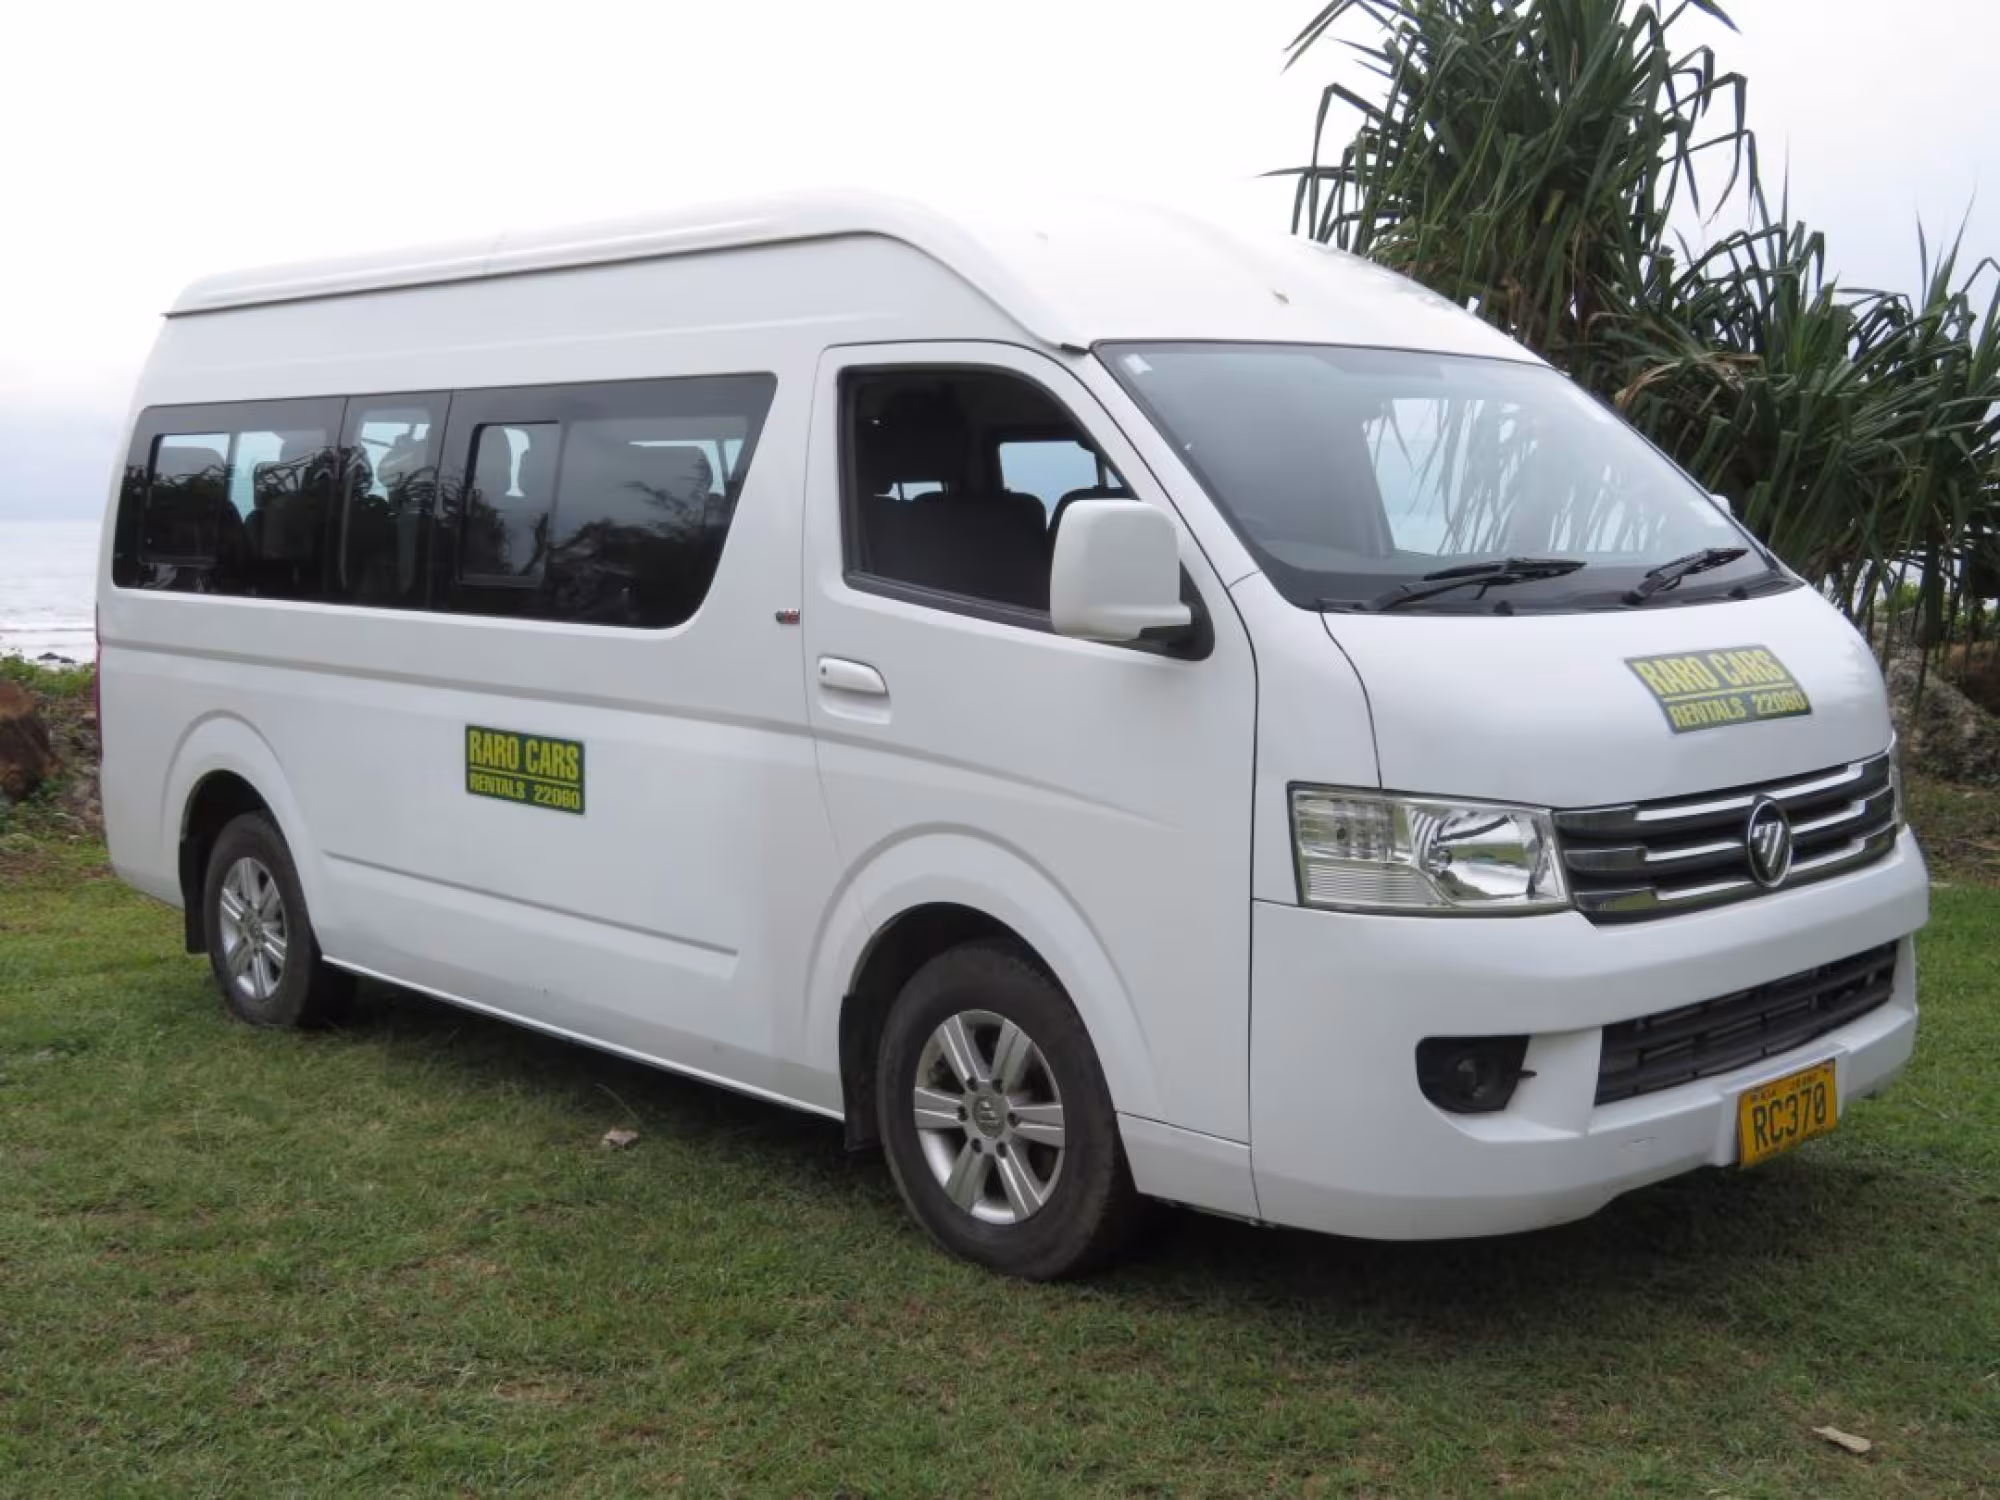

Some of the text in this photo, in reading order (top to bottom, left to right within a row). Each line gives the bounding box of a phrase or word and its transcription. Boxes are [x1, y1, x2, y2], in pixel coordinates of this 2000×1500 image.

[1632, 649, 1787, 696] RARO CARS
[1667, 698, 1746, 728] RENTALS
[469, 730, 579, 780] RARO CARS
[470, 773, 525, 799] RENTALS
[1752, 1081, 1827, 1153] RC370
